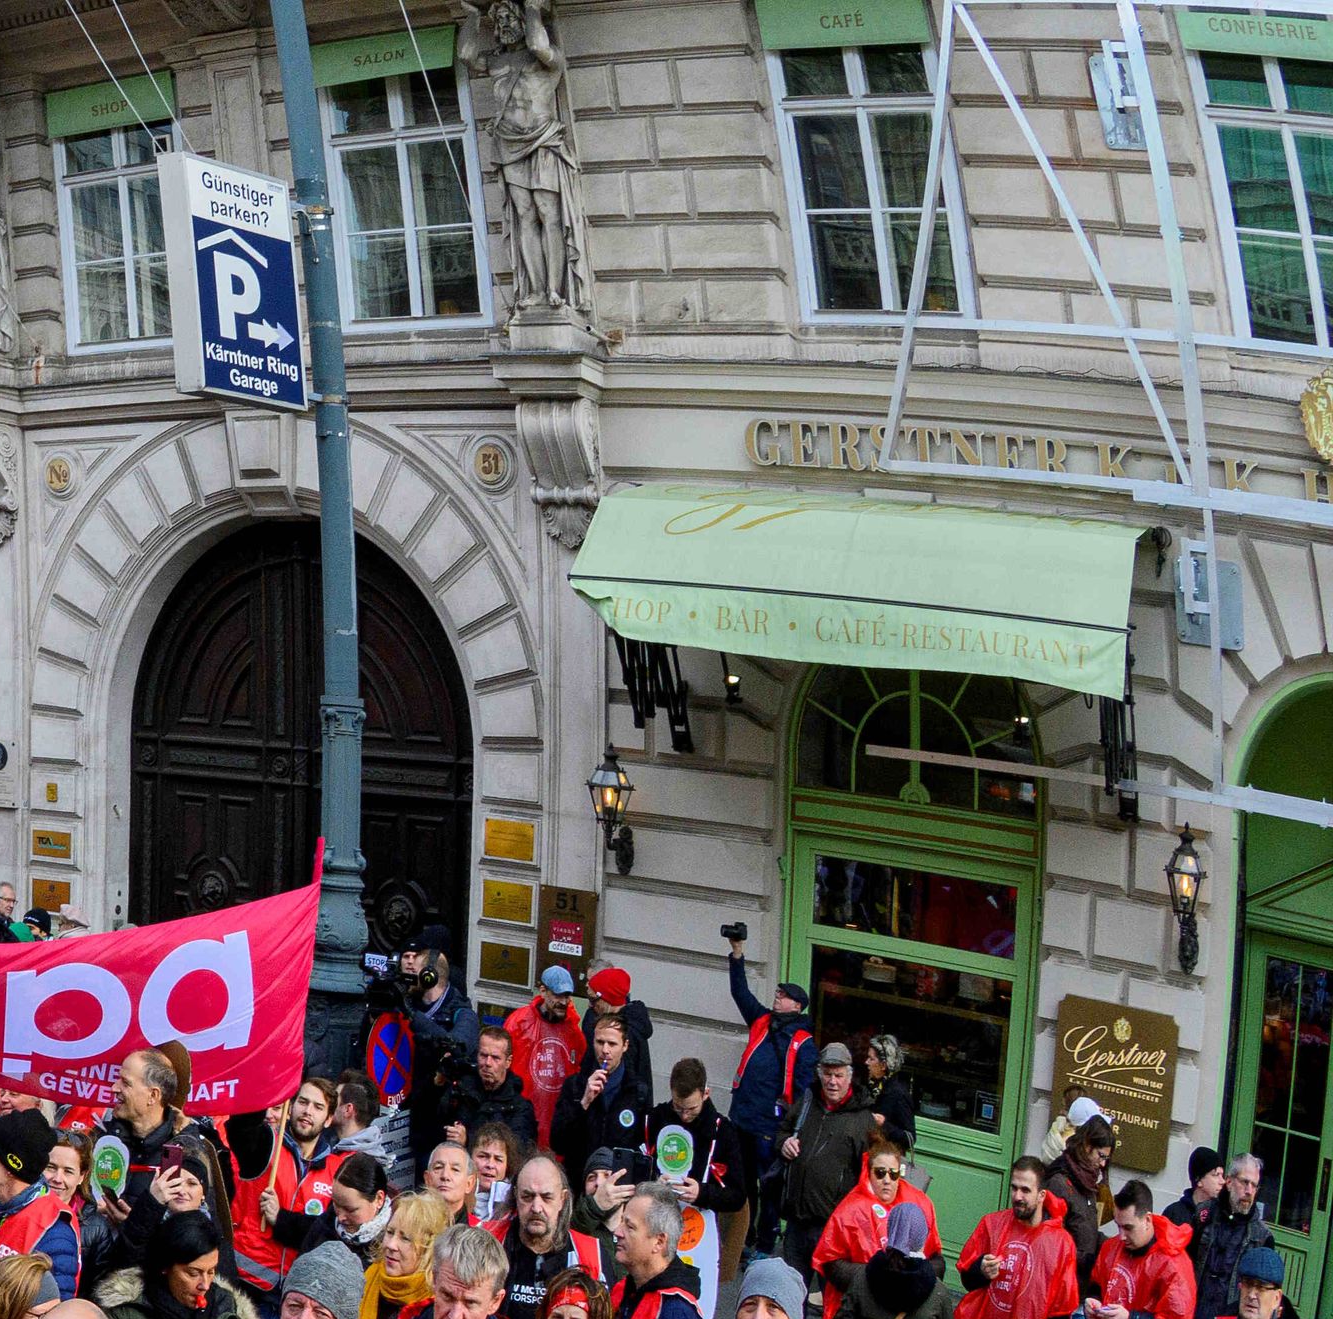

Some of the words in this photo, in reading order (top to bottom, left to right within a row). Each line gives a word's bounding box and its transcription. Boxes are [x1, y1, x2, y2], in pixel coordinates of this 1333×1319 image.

[818, 10, 865, 29] CAFÉ
[1207, 16, 1318, 41] CONFISERIE
[352, 48, 406, 69] SALON
[91, 101, 129, 119] SHOP
[200, 171, 274, 207] Günstiger
[209, 198, 270, 228] parken?
[204, 341, 265, 370] Kärntner
[265, 355, 298, 382] Ring
[228, 368, 278, 397] Garage
[609, 597, 672, 625] HOP
[715, 606, 769, 635] BAR
[815, 613, 1090, 671] CAFÉ-RESTAURANT
[367, 957, 386, 966] STOP
[1063, 1026, 1167, 1077] Gerstner
